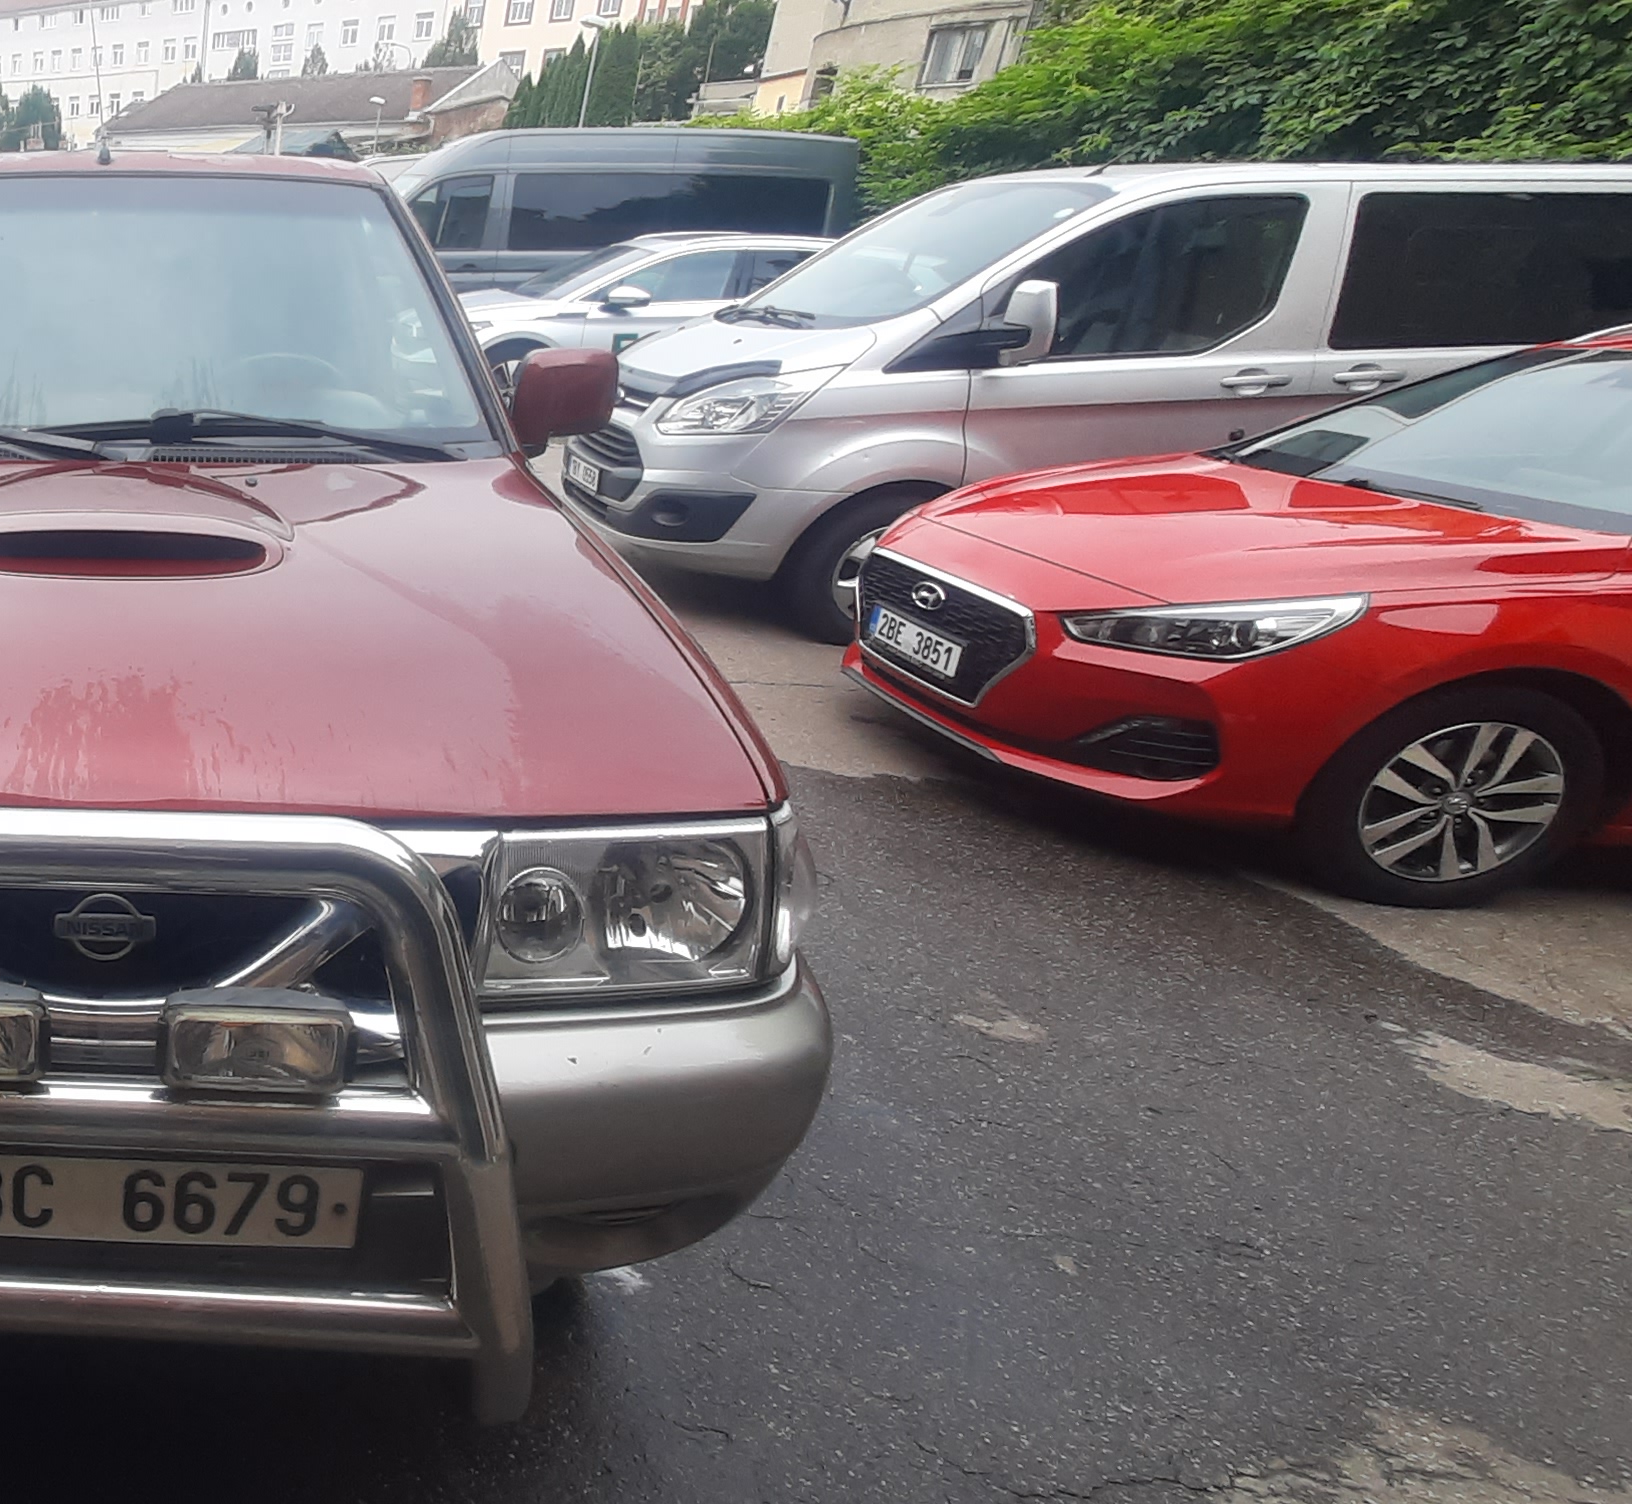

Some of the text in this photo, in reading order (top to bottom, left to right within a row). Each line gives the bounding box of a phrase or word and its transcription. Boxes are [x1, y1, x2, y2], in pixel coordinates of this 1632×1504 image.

[878, 613, 907, 645] 2BE
[912, 631, 954, 672] 3851
[121, 1168, 319, 1237] 6679
